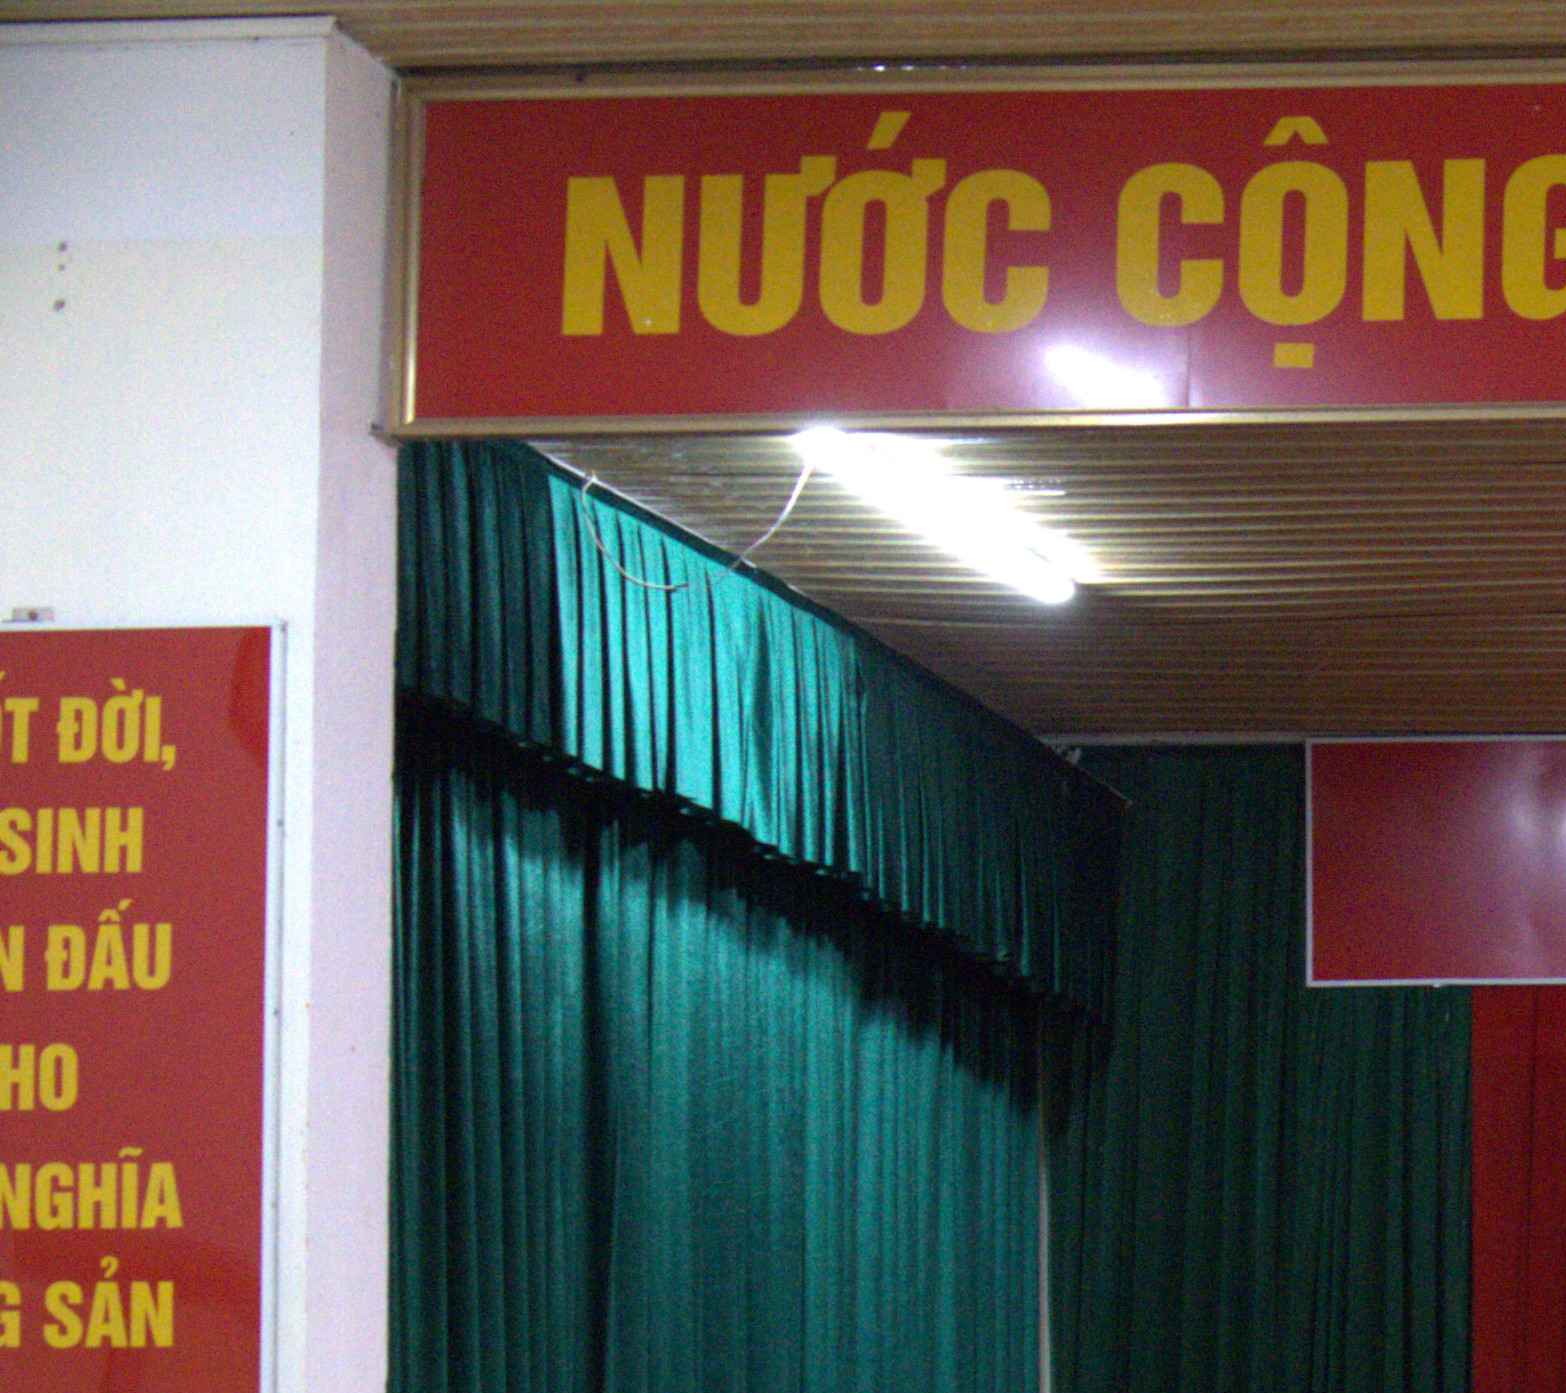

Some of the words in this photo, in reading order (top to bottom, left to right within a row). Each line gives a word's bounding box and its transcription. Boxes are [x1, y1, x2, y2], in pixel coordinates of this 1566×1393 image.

[562, 111, 1053, 337] NƯỚC
[56, 678, 176, 771] ĐỜI,
[0, 806, 144, 875] SINH
[45, 899, 172, 991] ĐẤU
[0, 1043, 79, 1112] HO
[0, 1146, 183, 1230] NGHĨA
[43, 1255, 174, 1349] SẢN
